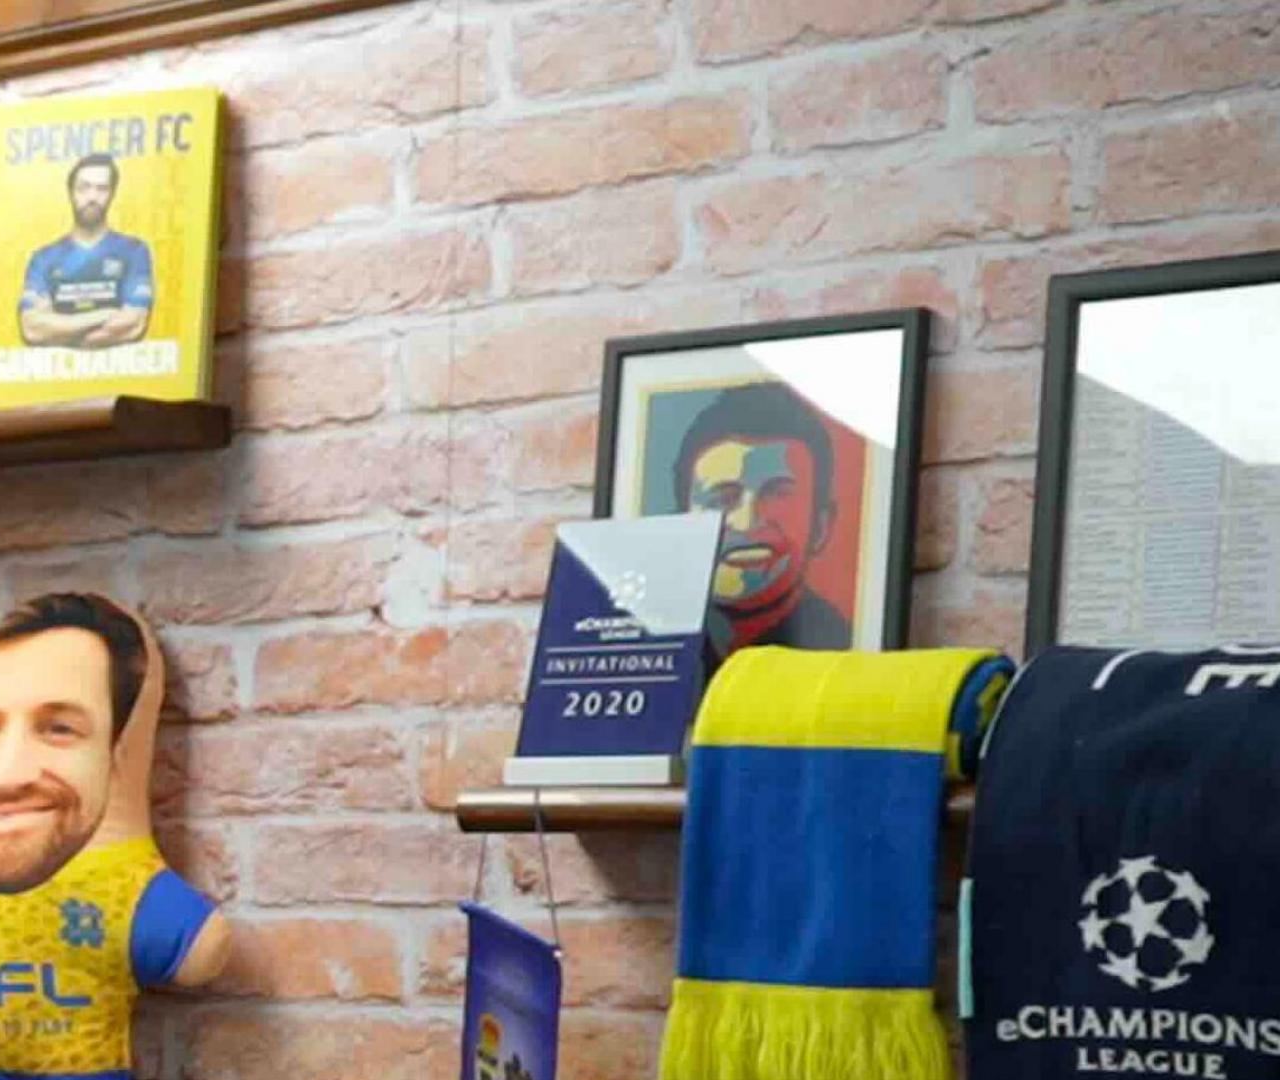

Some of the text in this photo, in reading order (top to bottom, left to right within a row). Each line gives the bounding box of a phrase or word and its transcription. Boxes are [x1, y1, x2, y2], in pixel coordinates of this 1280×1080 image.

[5, 112, 194, 166] SPENCER FC
[546, 654, 675, 674] INVITATIONAL
[561, 689, 645, 717] 2020
[997, 1004, 1280, 1056] eCHAMPIONS
[1077, 1047, 1227, 1080] LEAGUE
